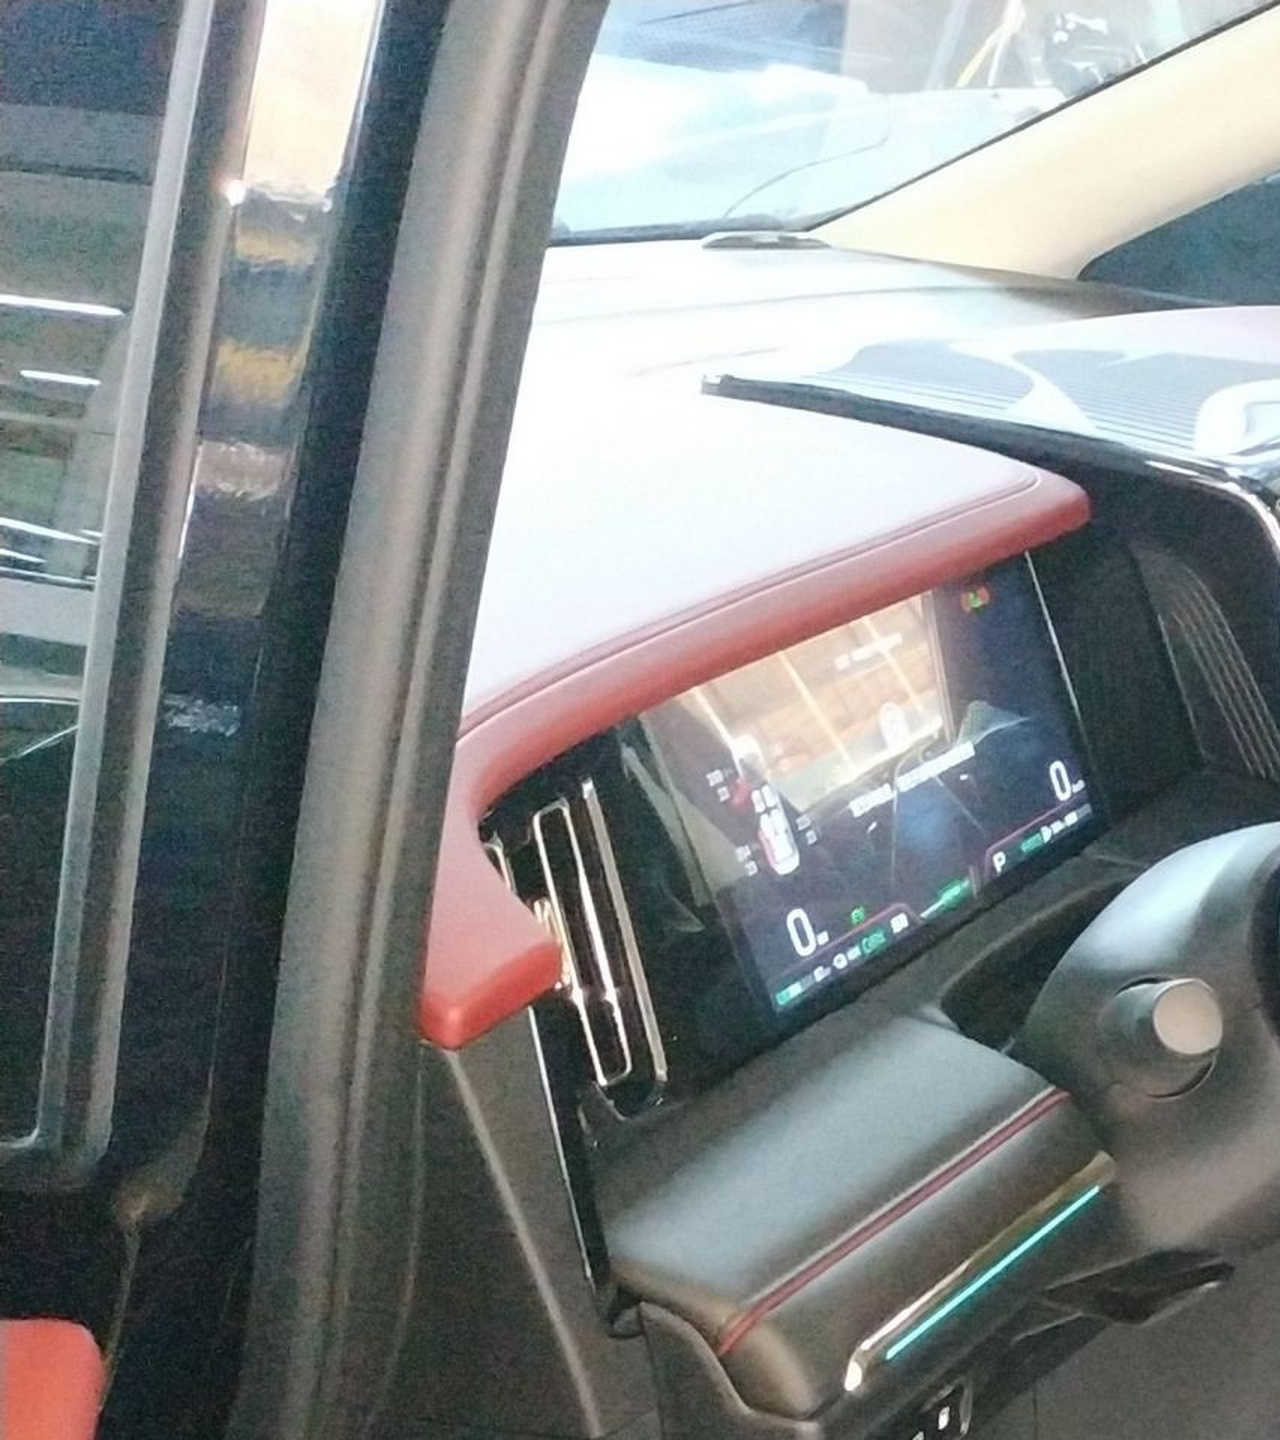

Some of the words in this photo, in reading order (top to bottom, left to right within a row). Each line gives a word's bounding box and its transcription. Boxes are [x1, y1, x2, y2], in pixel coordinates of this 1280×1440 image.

[1049, 760, 1072, 801] 0
[993, 851, 1006, 873] P
[786, 908, 817, 957] 0
